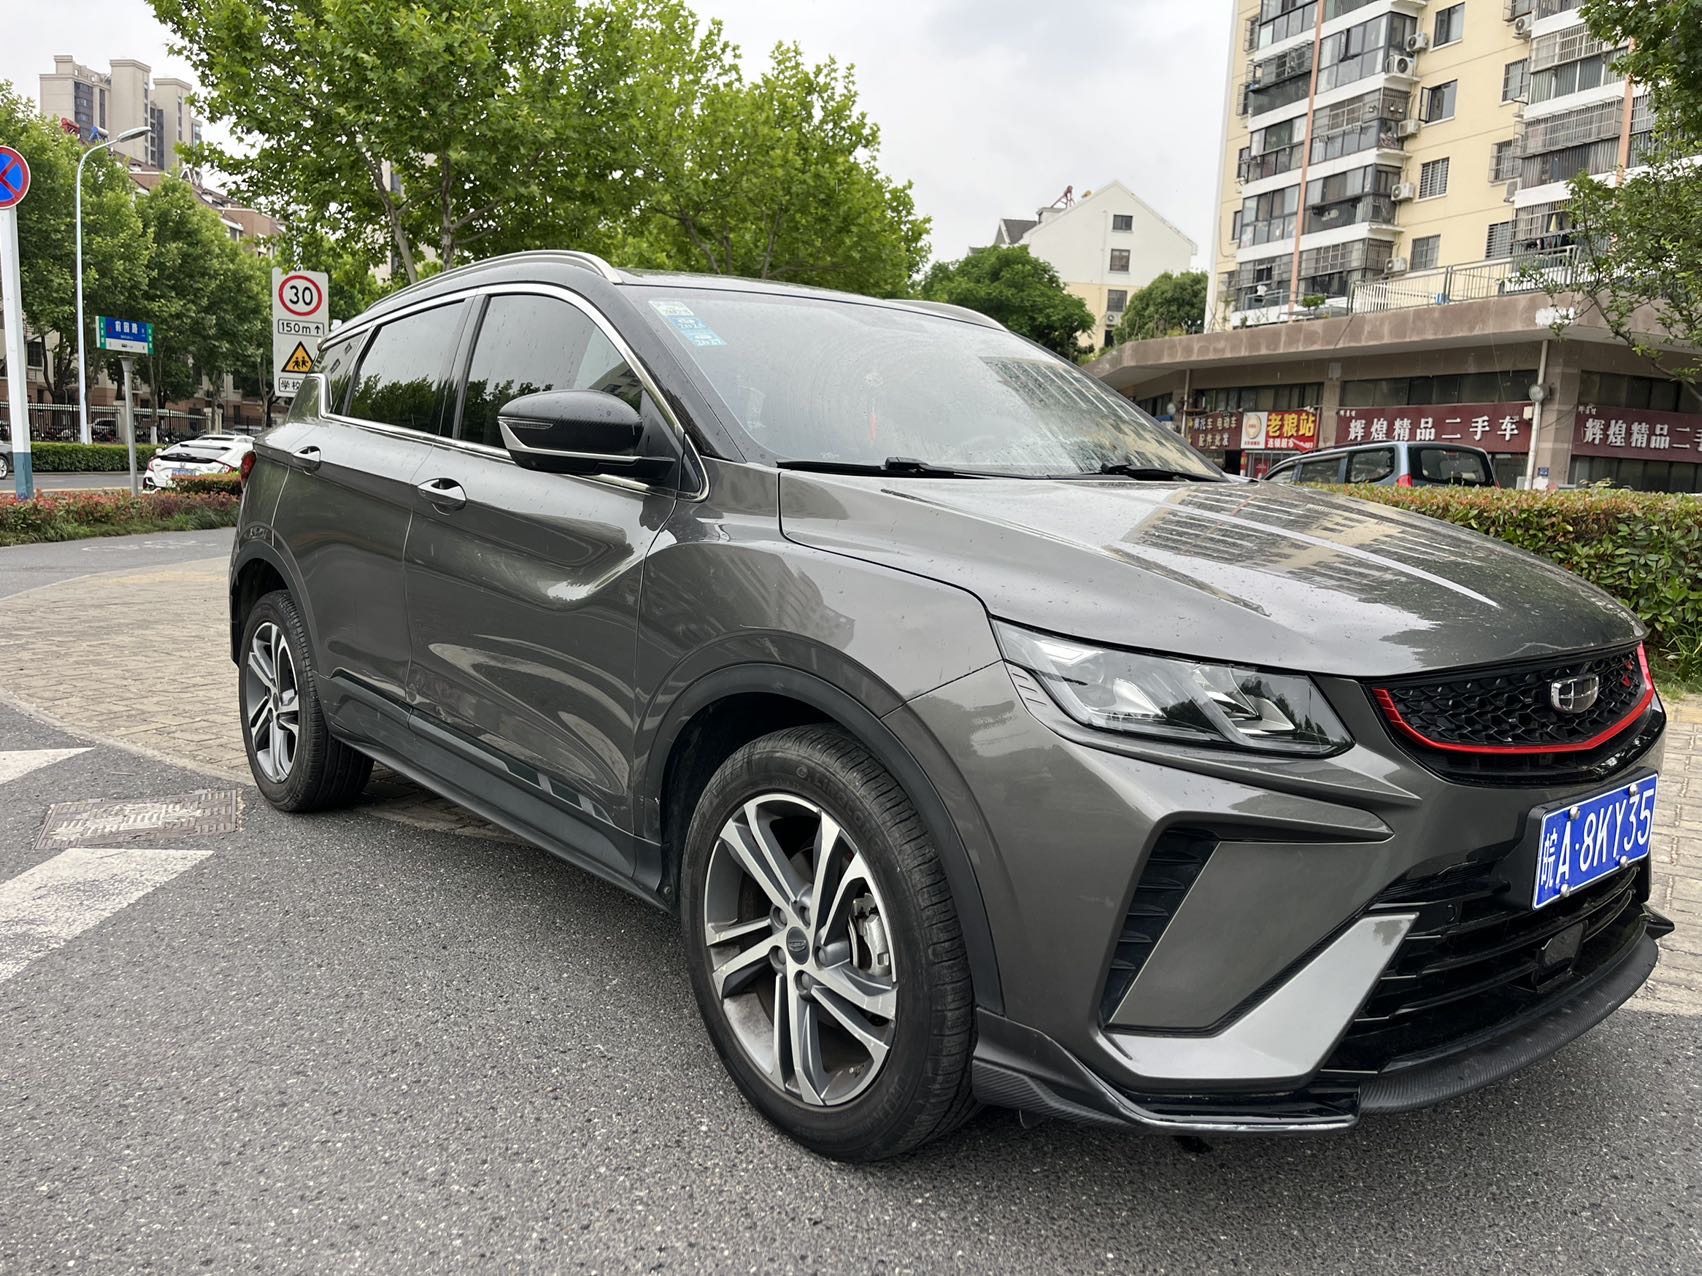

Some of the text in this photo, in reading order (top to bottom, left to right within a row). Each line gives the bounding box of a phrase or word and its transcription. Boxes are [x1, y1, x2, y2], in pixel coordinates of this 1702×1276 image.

[289, 285, 313, 306] 30
[281, 321, 311, 334] 150m
[1267, 412, 1315, 437] 老粮站
[1347, 415, 1519, 441] 辉煌精品二手车
[1540, 788, 1655, 890] 皖A·8KY35
